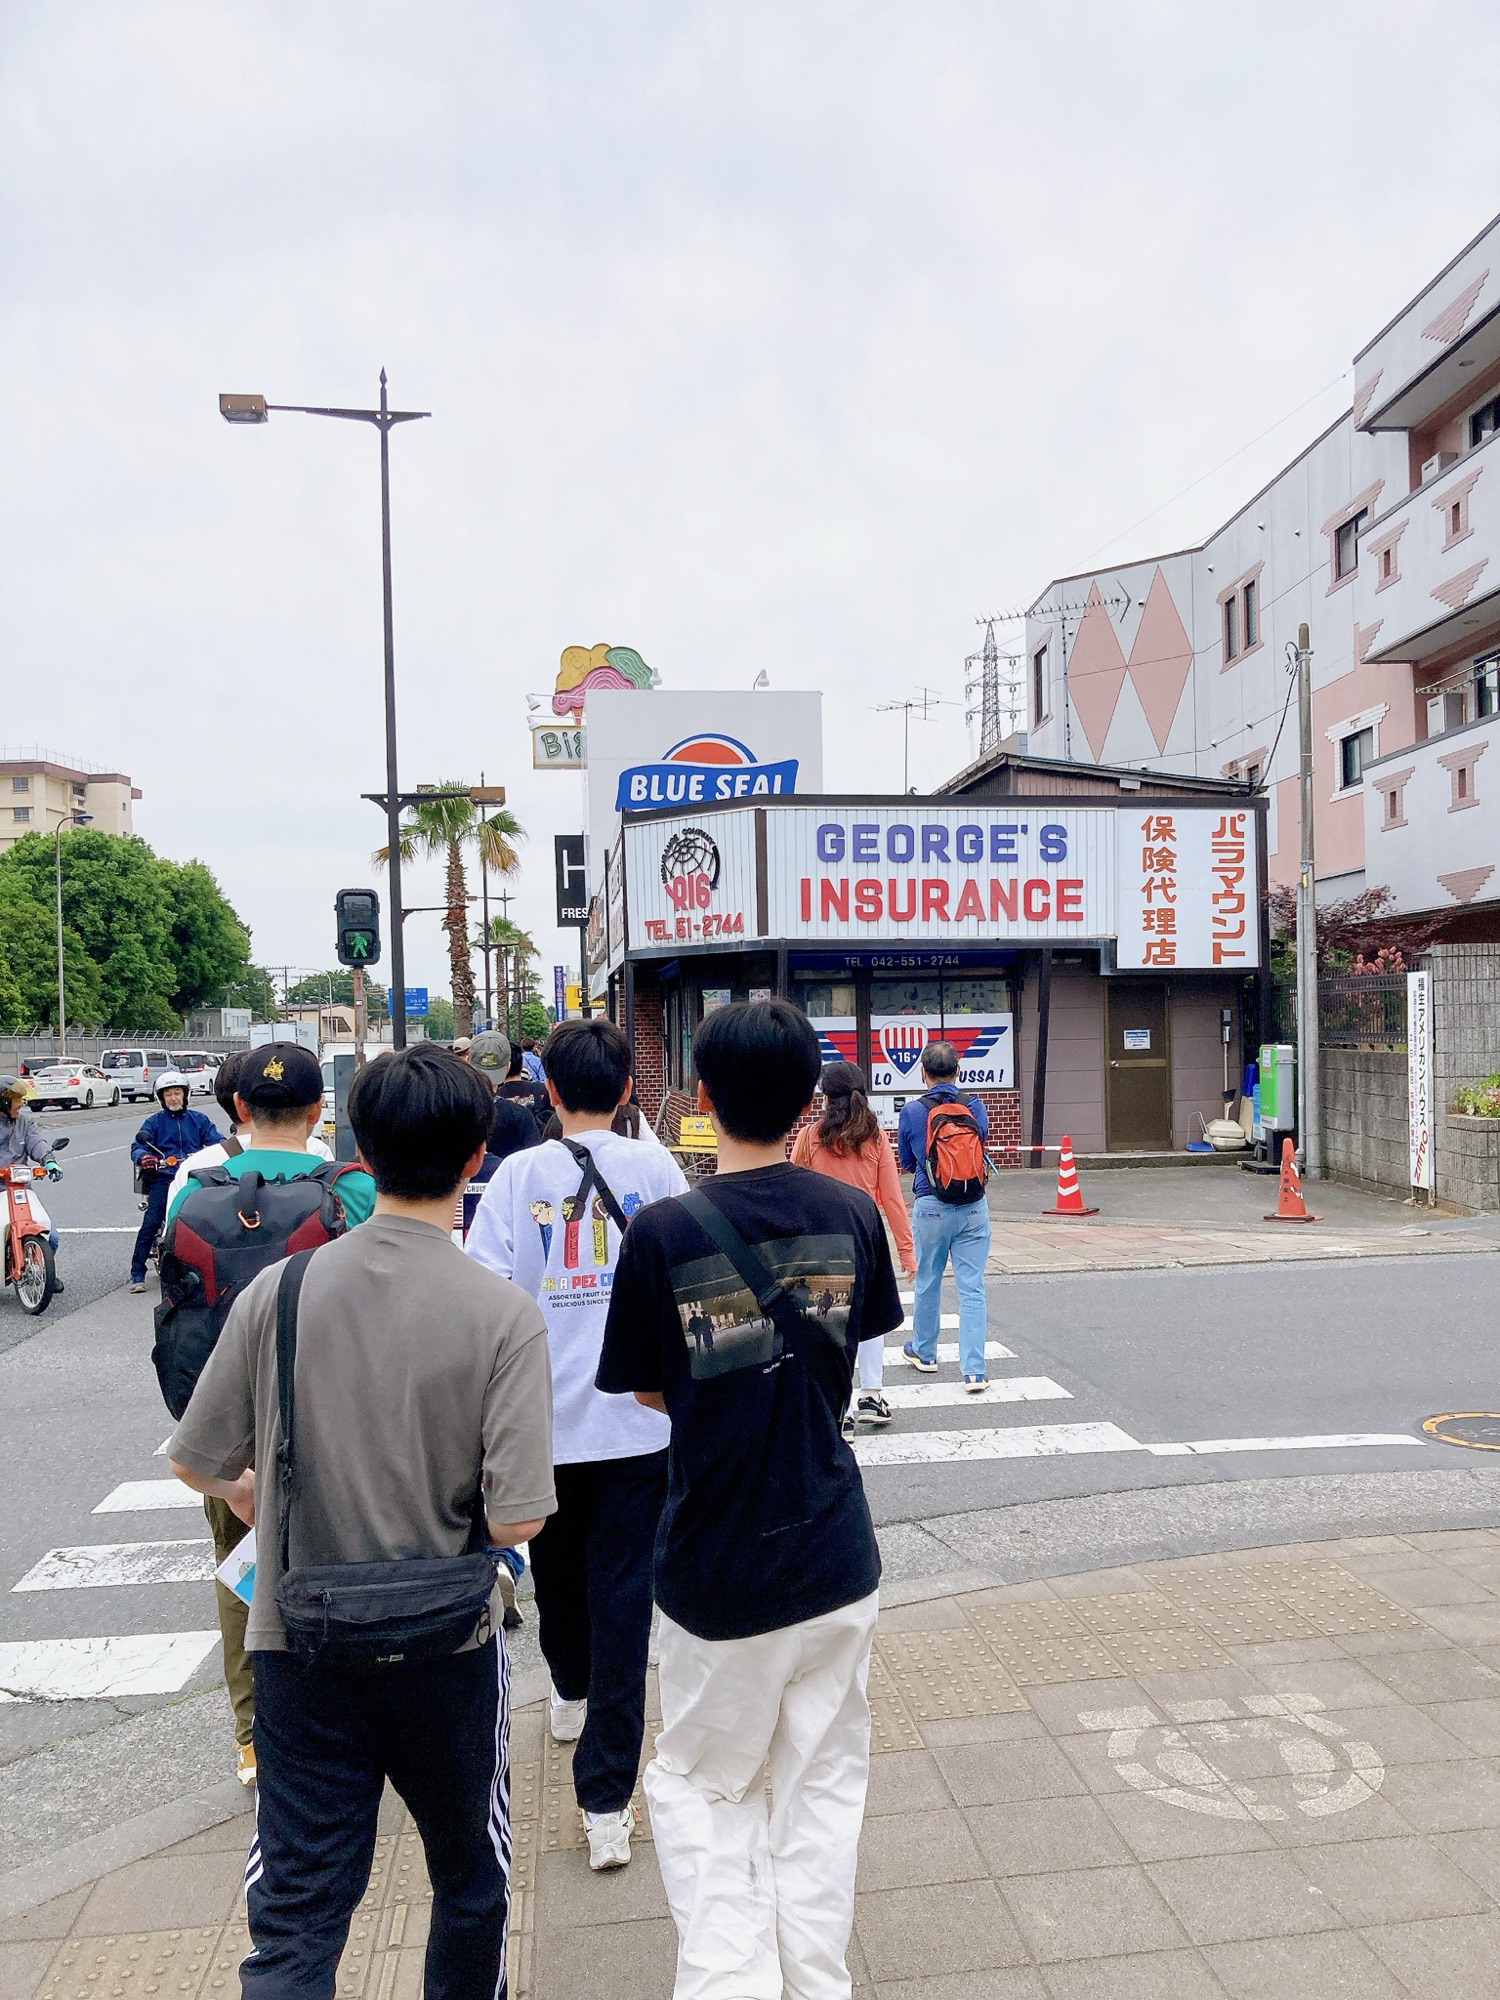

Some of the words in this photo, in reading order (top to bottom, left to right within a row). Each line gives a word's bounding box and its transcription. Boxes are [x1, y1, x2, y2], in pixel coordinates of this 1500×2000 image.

[629, 774, 706, 802] BLUE
[681, 827, 716, 846] COMPANY
[816, 823, 1068, 863] GEORGE'S
[800, 878, 1084, 922] INSURANCE
[1141, 815, 1178, 965] 保険代理店
[1211, 813, 1246, 965] パラマウント
[644, 919, 673, 941] TEL
[675, 912, 744, 940] 51-2744
[844, 957, 864, 968] TEL
[871, 956, 960, 967] 042-551-2744
[897, 1052, 911, 1063] 16
[1414, 1130, 1429, 1184] OPEN
[560, 1276, 568, 1290] A
[571, 1273, 597, 1289] PEZ
